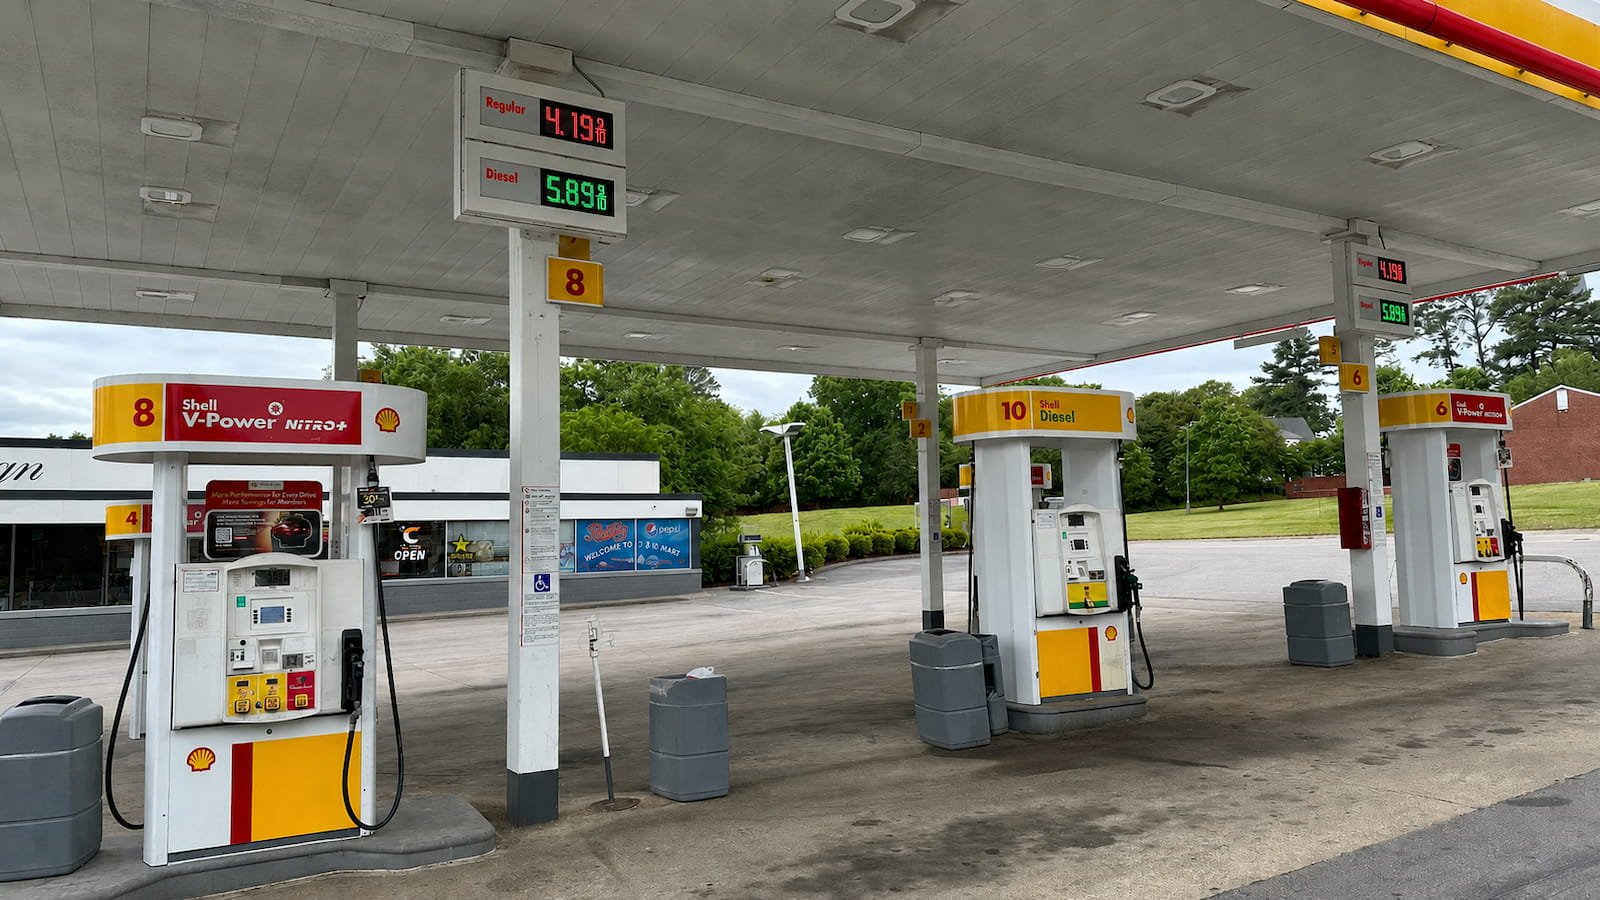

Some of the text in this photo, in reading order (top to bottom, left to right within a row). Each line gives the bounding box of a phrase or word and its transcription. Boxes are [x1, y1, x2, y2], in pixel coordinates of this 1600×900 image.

[486, 96, 526, 115] Regular
[545, 106, 594, 141] 4.19
[486, 167, 518, 184] Diesel
[546, 174, 595, 208] 5.89
[565, 268, 585, 296] 8
[1353, 369, 1362, 386] 6
[133, 398, 155, 427] 8
[182, 399, 217, 411] Shell
[1001, 400, 1026, 420] 10
[1039, 400, 1060, 409] Shell
[1436, 401, 1448, 416] 6
[182, 412, 277, 429] V-Power
[1040, 410, 1075, 423] Diesel
[918, 423, 925, 434] 2
[126, 511, 138, 525] 4
[658, 524, 680, 535] pepsi
[394, 549, 426, 561] OPEN
[584, 543, 621, 561] WELCOME
[660, 545, 681, 557] MART
